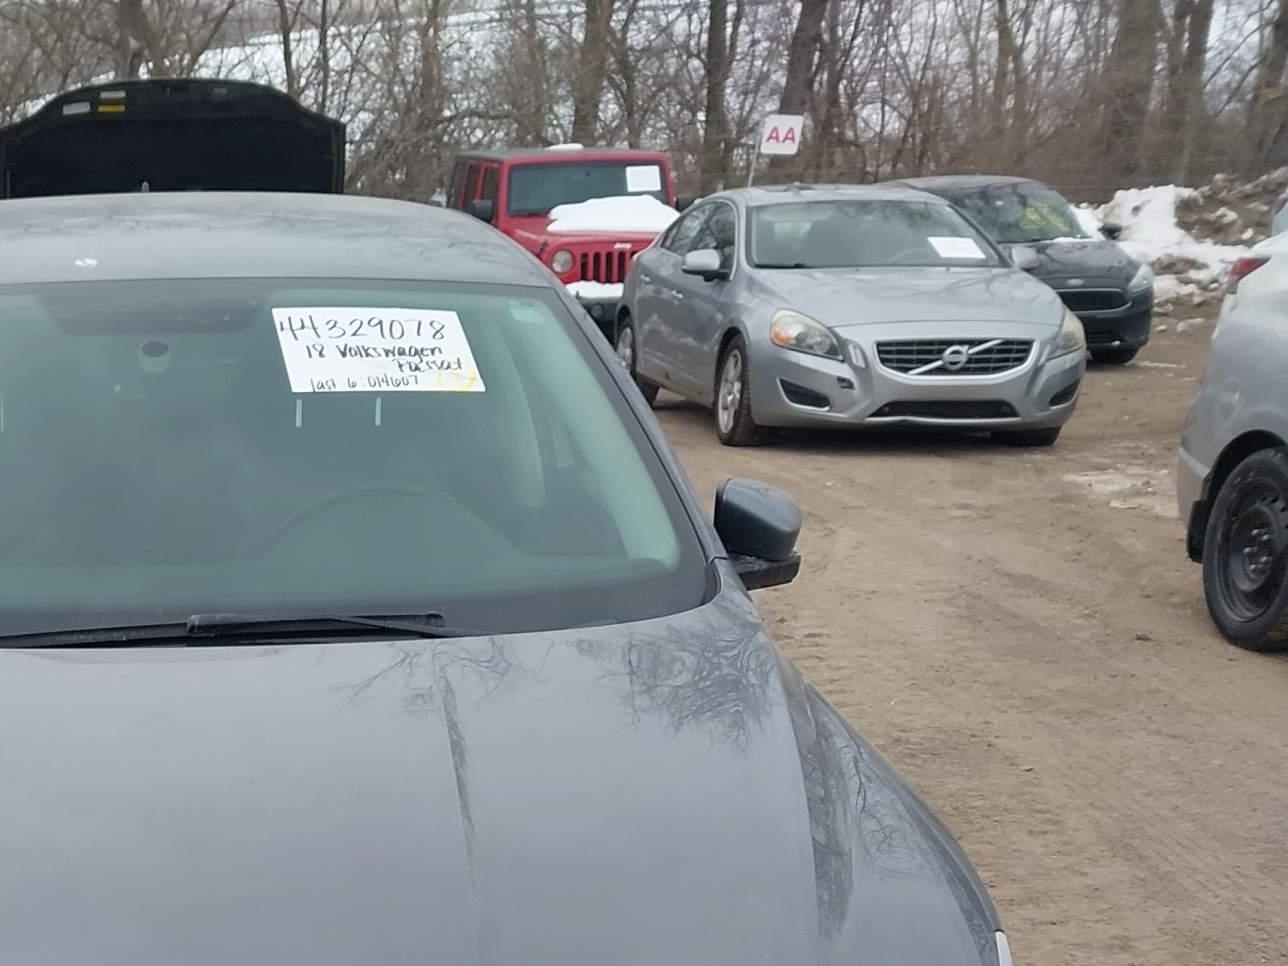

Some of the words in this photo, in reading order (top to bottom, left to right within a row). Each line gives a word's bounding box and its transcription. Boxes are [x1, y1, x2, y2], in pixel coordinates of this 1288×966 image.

[765, 126, 796, 144] AA
[279, 315, 446, 341] 44329078
[305, 344, 326, 359] 18
[334, 342, 444, 363] Volkswagen
[391, 357, 464, 374] Passat
[310, 378, 337, 393] last
